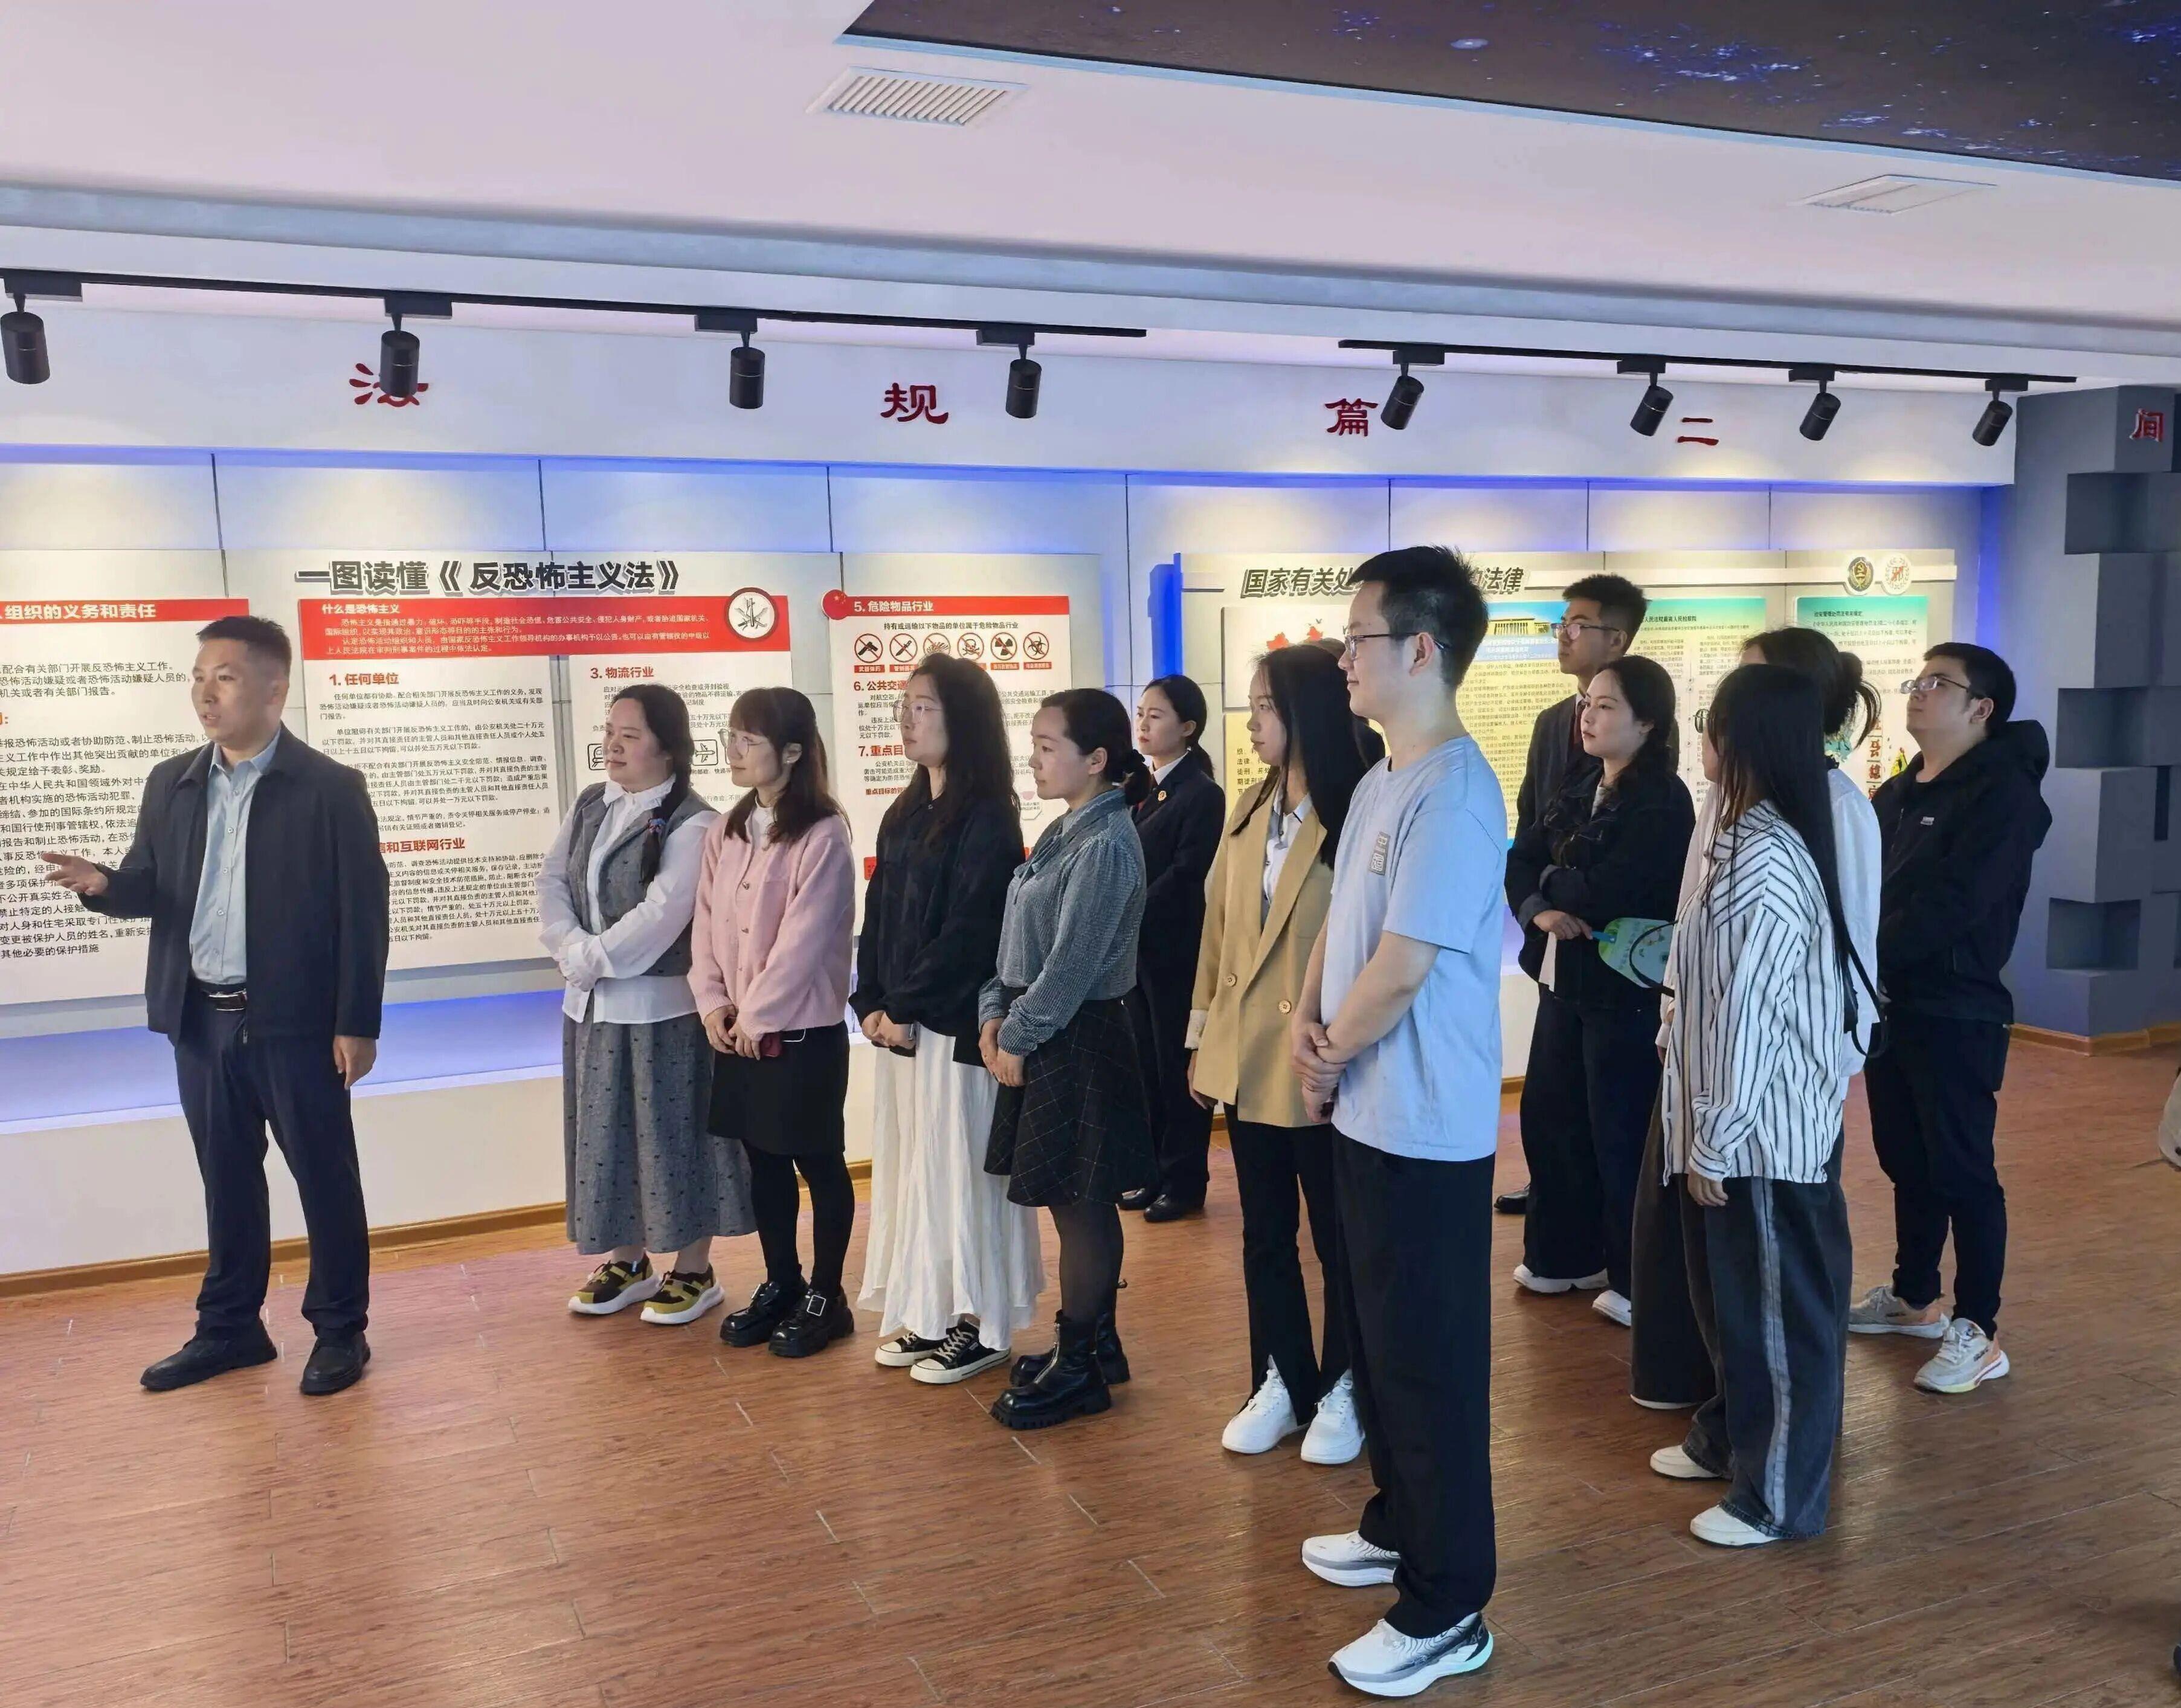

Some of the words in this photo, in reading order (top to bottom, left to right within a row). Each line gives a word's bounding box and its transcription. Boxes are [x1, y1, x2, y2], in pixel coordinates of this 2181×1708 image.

[880, 382, 949, 424] 规
[1325, 398, 1379, 437] 篇
[295, 559, 680, 595] 一图读懂《反恐怖主义法》
[0, 603, 156, 619] 组织的义务和责任
[321, 604, 401, 614] 什么是恐怖主义
[868, 600, 934, 612] 危险物品行业
[605, 666, 654, 678] 物流行业
[0, 776, 147, 791] 在中华人民共和国领域外对中
[368, 782, 549, 798] 以下罚款，并对其直接负责的主管人员和其他直接责任人员
[0, 832, 135, 847] 报告和制止恐怖活动，在恐
[1, 943, 100, 959] 其他必要的保护措施
